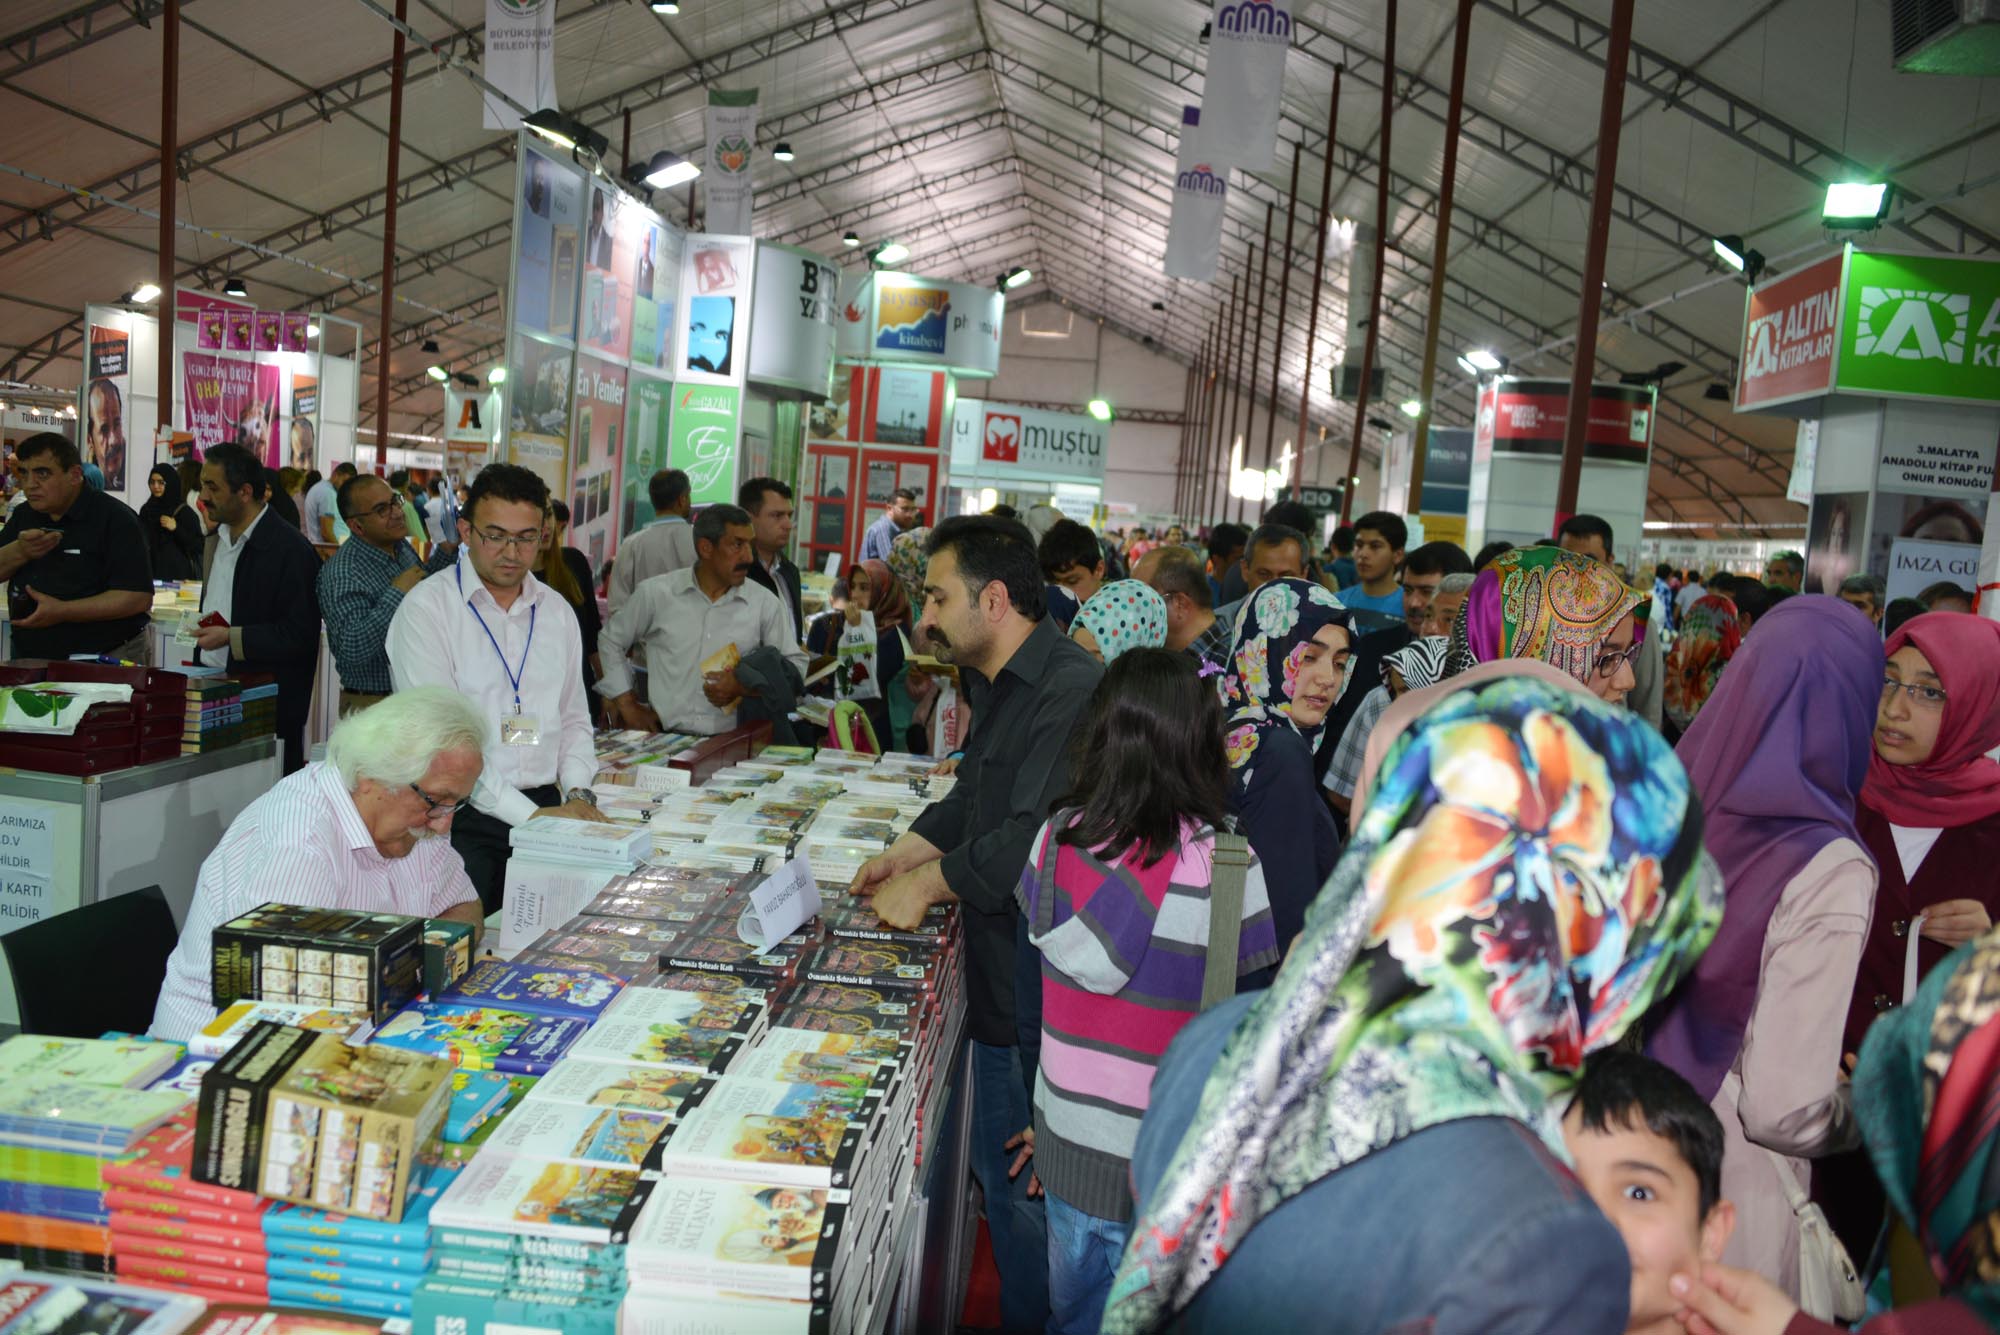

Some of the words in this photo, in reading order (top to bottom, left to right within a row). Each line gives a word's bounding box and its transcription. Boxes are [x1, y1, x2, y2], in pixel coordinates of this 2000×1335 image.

[1782, 286, 1839, 344] ALTIN
[899, 329, 944, 348] kitabevi
[1779, 333, 1833, 372] KİTAPLAR
[196, 379, 221, 399] OHA
[576, 367, 589, 397] En
[593, 373, 625, 405] Yeniler
[1023, 425, 1101, 456] muştu
[1917, 445, 1980, 460] 3.MALATYA
[1882, 456, 1937, 470] ANADOLU
[1940, 461, 1974, 473] KİTAP
[1902, 472, 1935, 484] ONUR
[1937, 475, 1988, 489] KONUĞU
[1897, 551, 1943, 574] İMZA
[6, 882, 43, 898] KARTI
